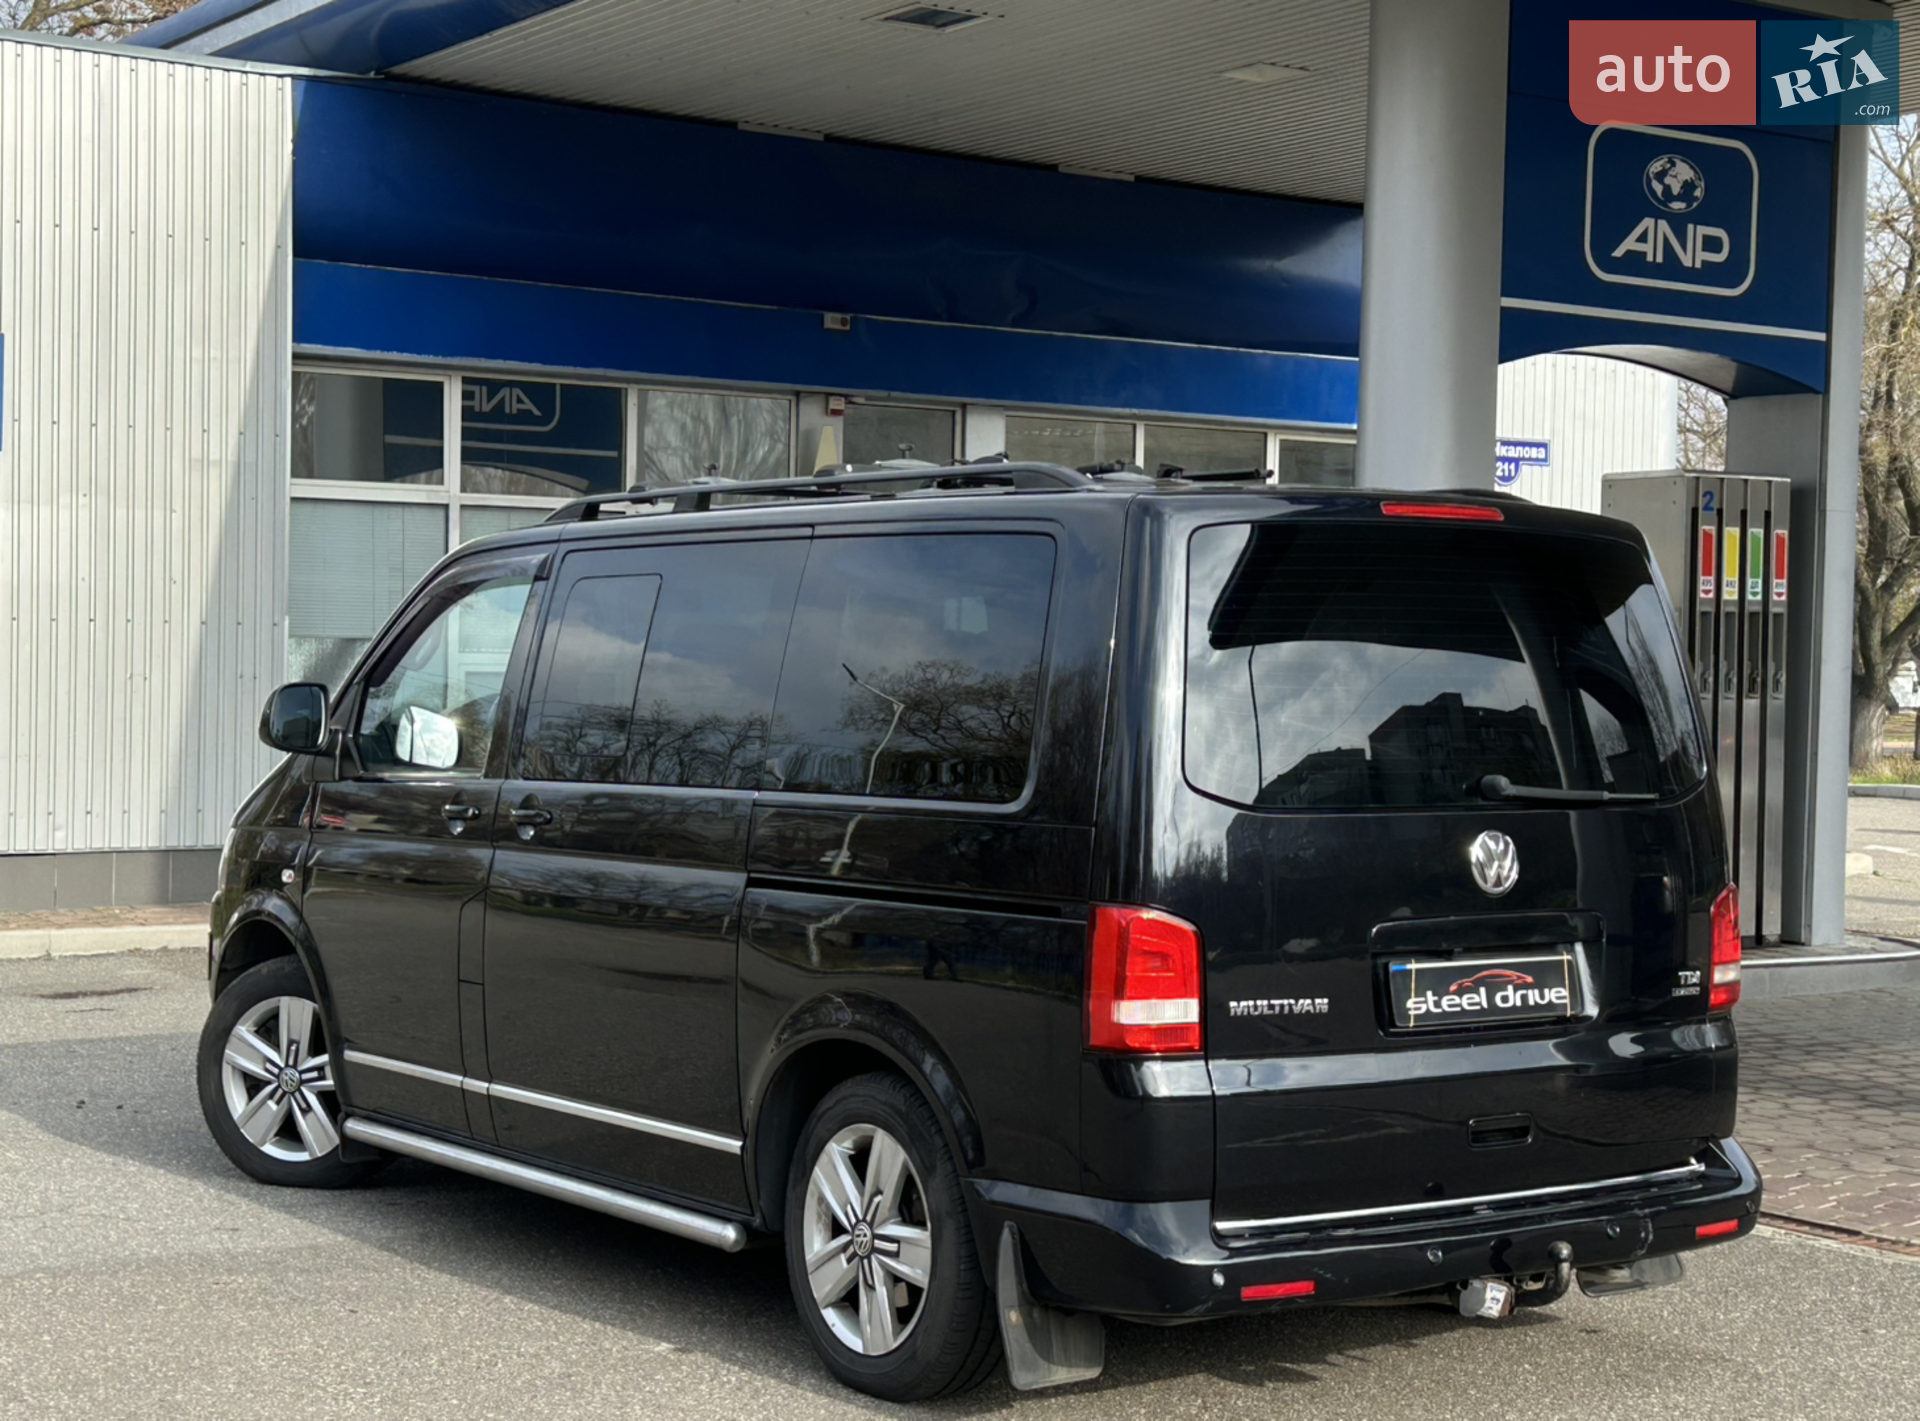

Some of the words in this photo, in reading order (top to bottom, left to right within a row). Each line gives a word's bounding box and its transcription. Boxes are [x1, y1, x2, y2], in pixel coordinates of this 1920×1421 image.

[1611, 216, 1730, 269] ANP
[1495, 461, 1516, 477] 211
[1702, 490, 1715, 512] 2
[1229, 998, 1329, 1016] MULTIVAN
[1406, 986, 1488, 1015] steel
[1494, 985, 1568, 1008] drive
